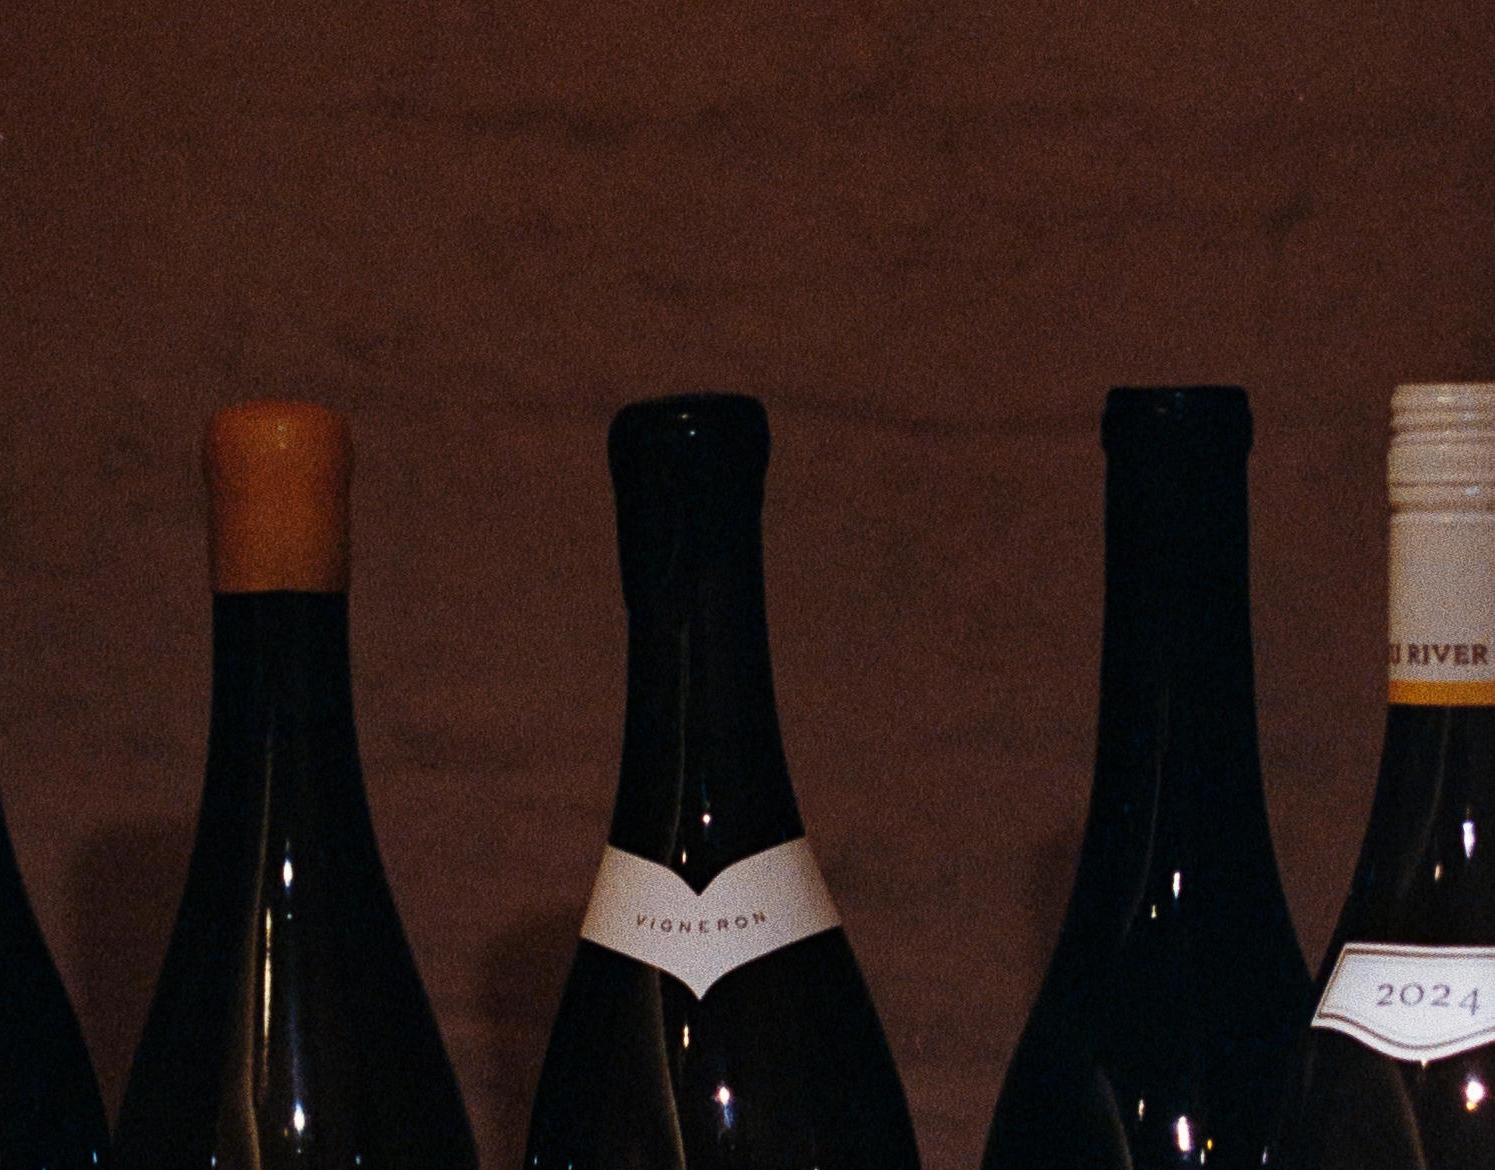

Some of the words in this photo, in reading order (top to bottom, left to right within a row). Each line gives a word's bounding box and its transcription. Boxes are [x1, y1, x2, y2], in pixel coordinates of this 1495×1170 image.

[1408, 643, 1489, 666] RIVER
[636, 911, 767, 934] VIGNERON
[1376, 982, 1480, 1016] 2024
